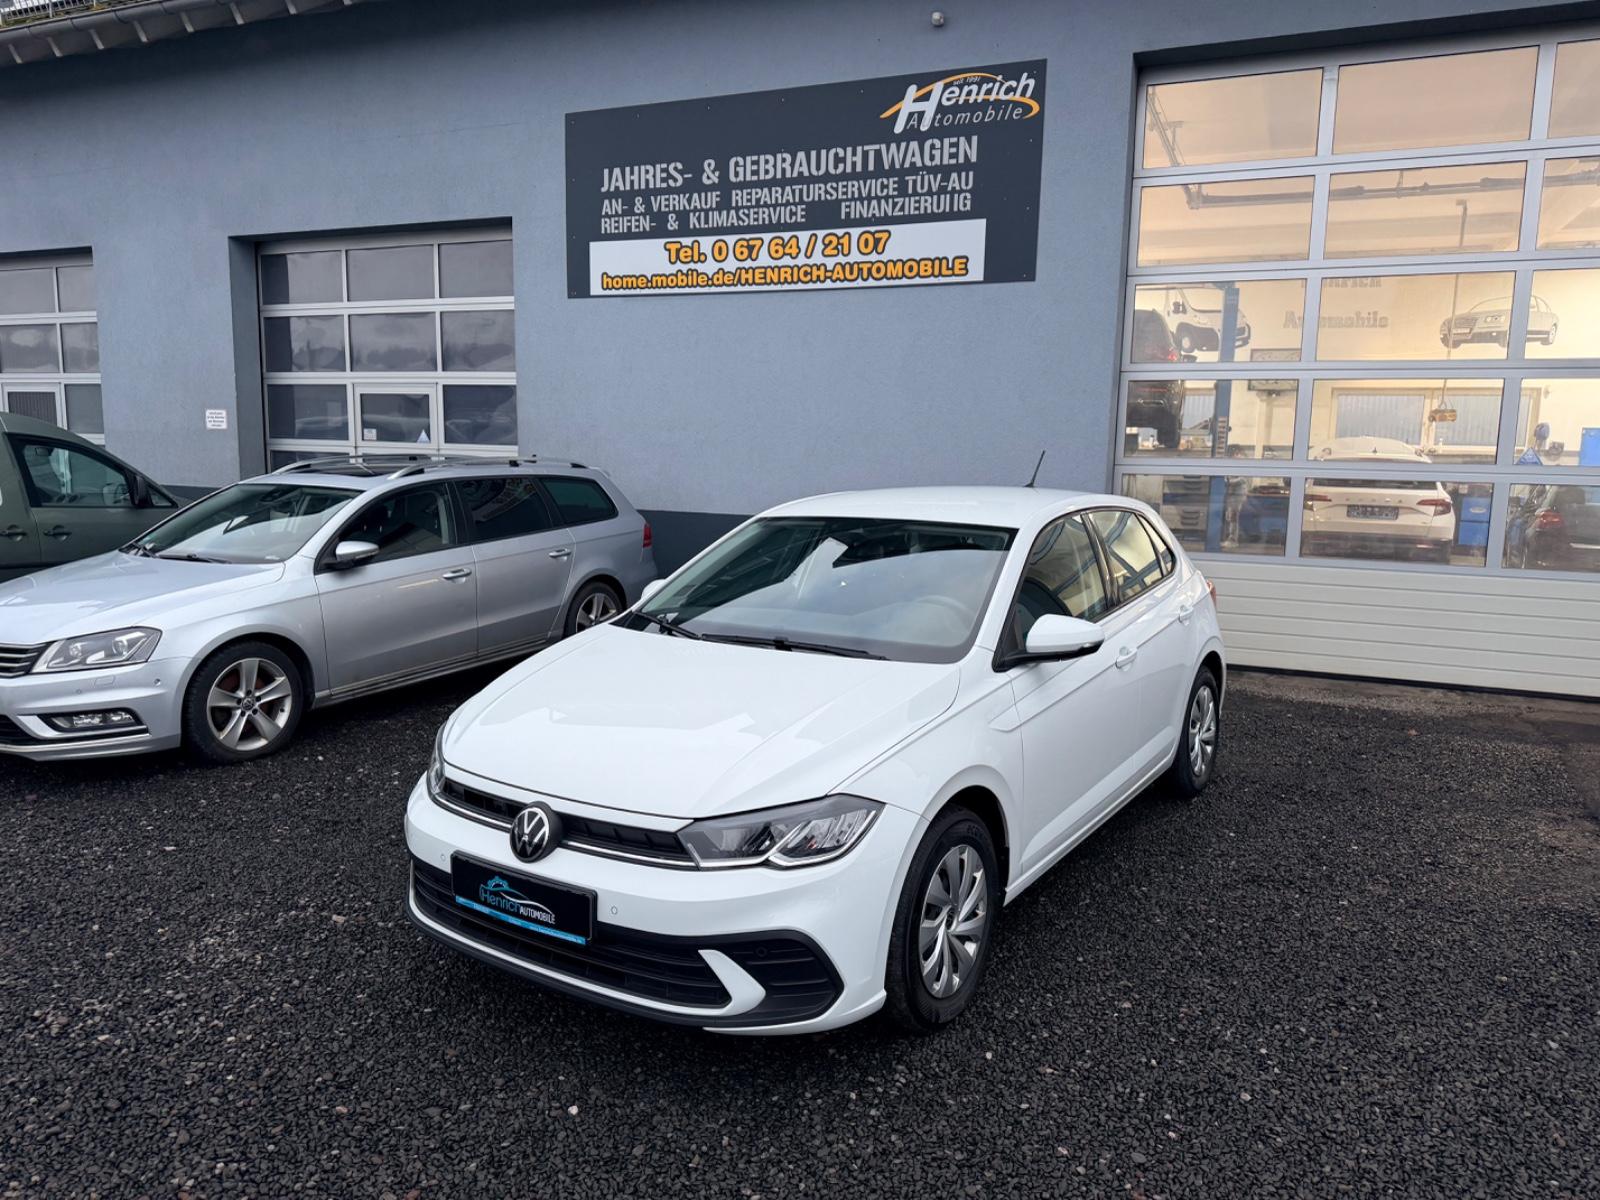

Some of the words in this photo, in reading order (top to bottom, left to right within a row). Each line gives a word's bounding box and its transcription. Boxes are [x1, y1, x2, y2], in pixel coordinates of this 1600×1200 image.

[893, 72, 1035, 134] Henrich
[601, 161, 693, 193] JAHRES-
[702, 158, 720, 185] &
[728, 135, 979, 183] GEBRAUCHTWAGEN
[601, 199, 628, 216] AN-
[634, 196, 645, 214] &
[651, 191, 721, 213] VERKAUF
[731, 177, 899, 208] REPARATURSERVICE
[905, 171, 975, 195] TÜV-AU
[601, 214, 657, 235] REIFEN-
[667, 213, 679, 231] &
[689, 204, 807, 230] KLIMASERVICE
[664, 240, 707, 265] Tel.
[711, 238, 729, 263] 0
[733, 237, 764, 262] 67
[767, 234, 800, 260] 64
[804, 233, 818, 259] /
[602, 256, 969, 291] home.mobile.de/HENRICH-AUTOMOBILE
